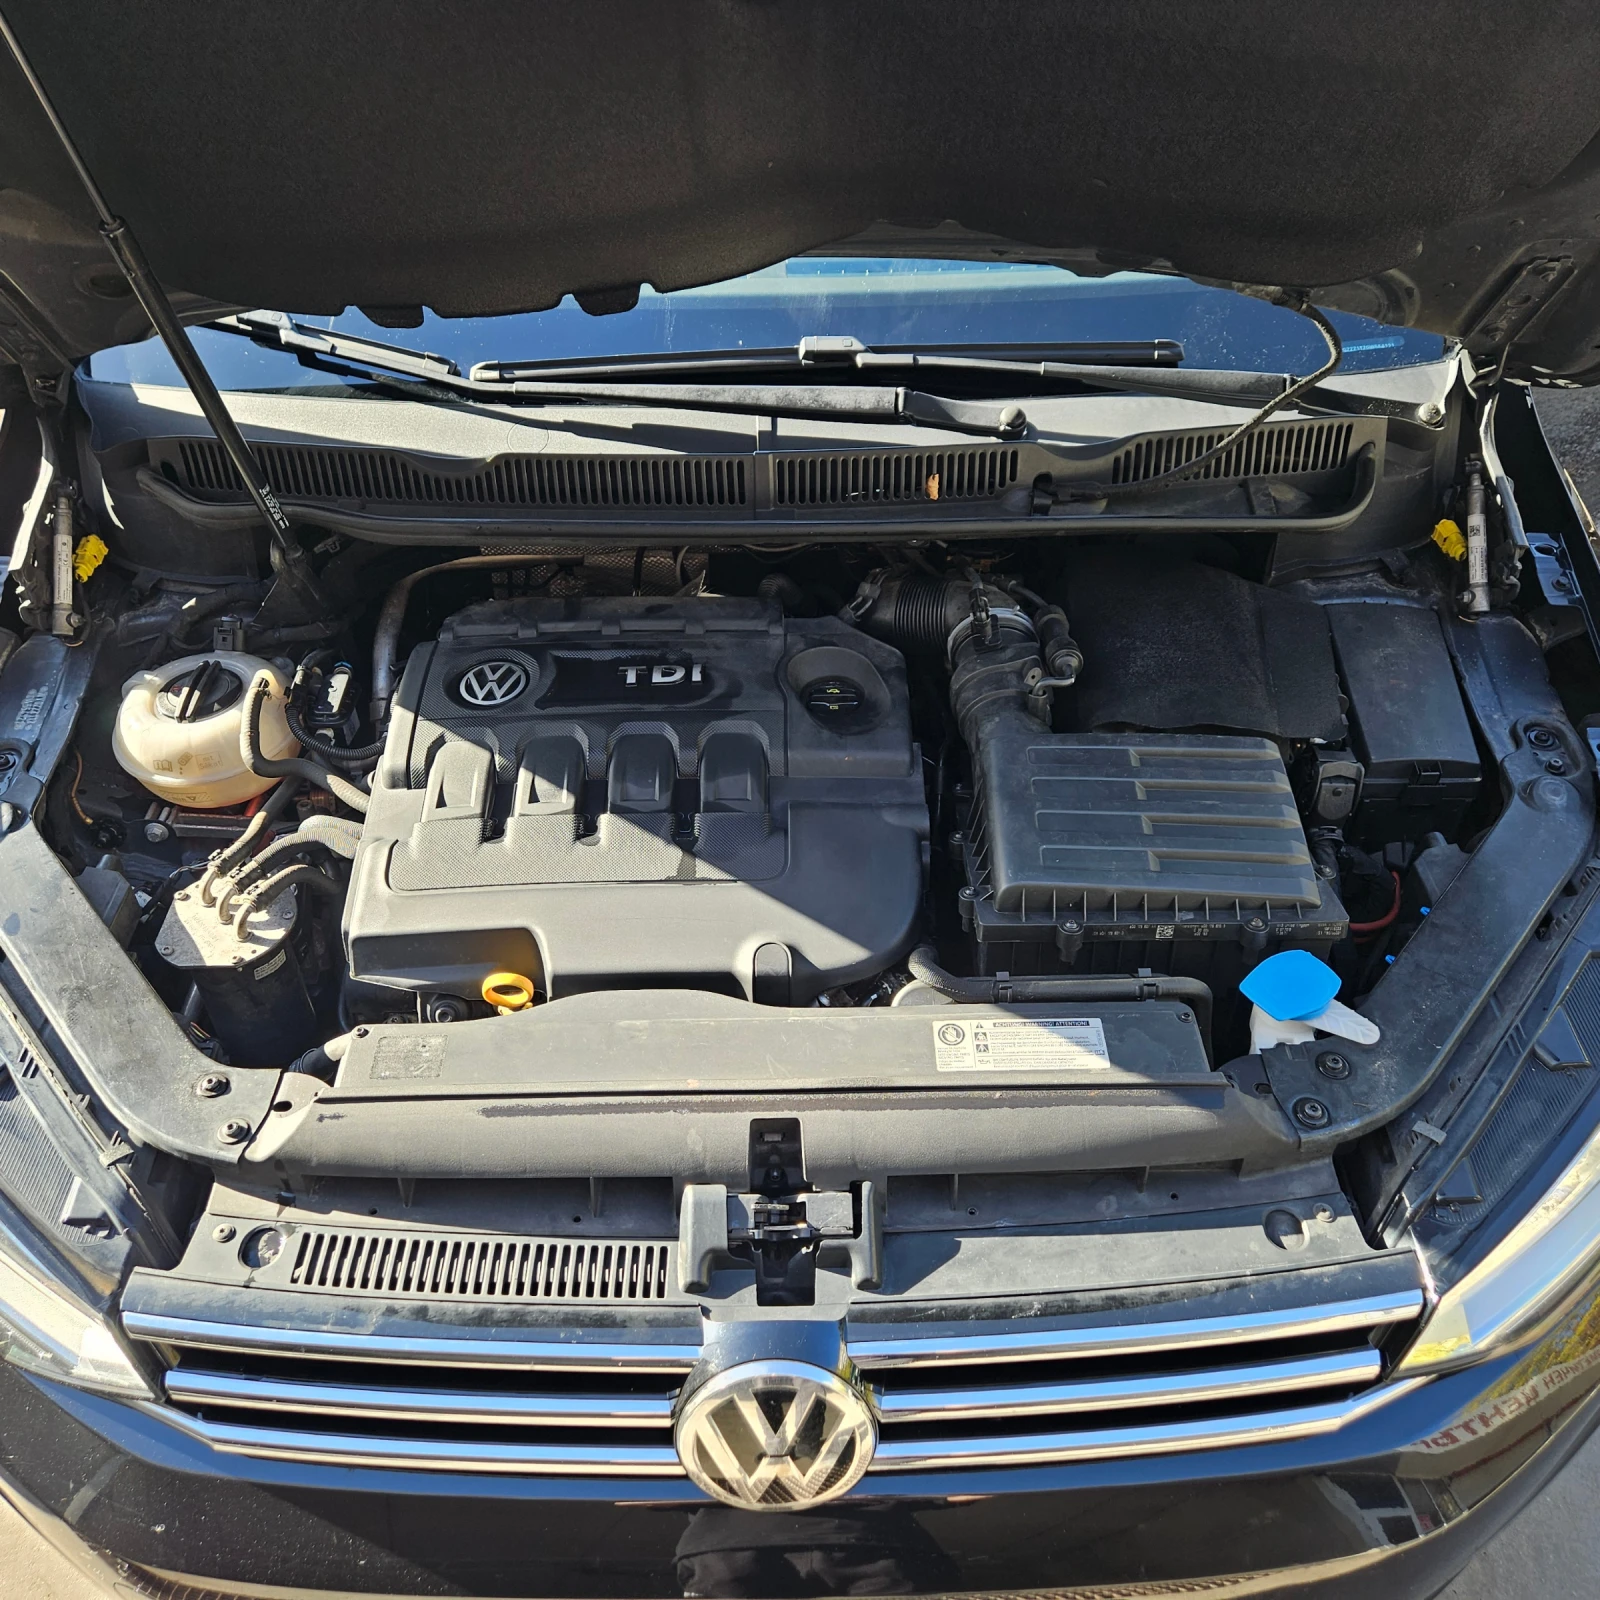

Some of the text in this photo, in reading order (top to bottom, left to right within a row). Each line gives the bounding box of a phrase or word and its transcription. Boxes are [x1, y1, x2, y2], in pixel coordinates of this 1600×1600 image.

[459, 661, 527, 705] VW
[617, 664, 703, 688] TDI
[677, 1363, 875, 1510] VW
